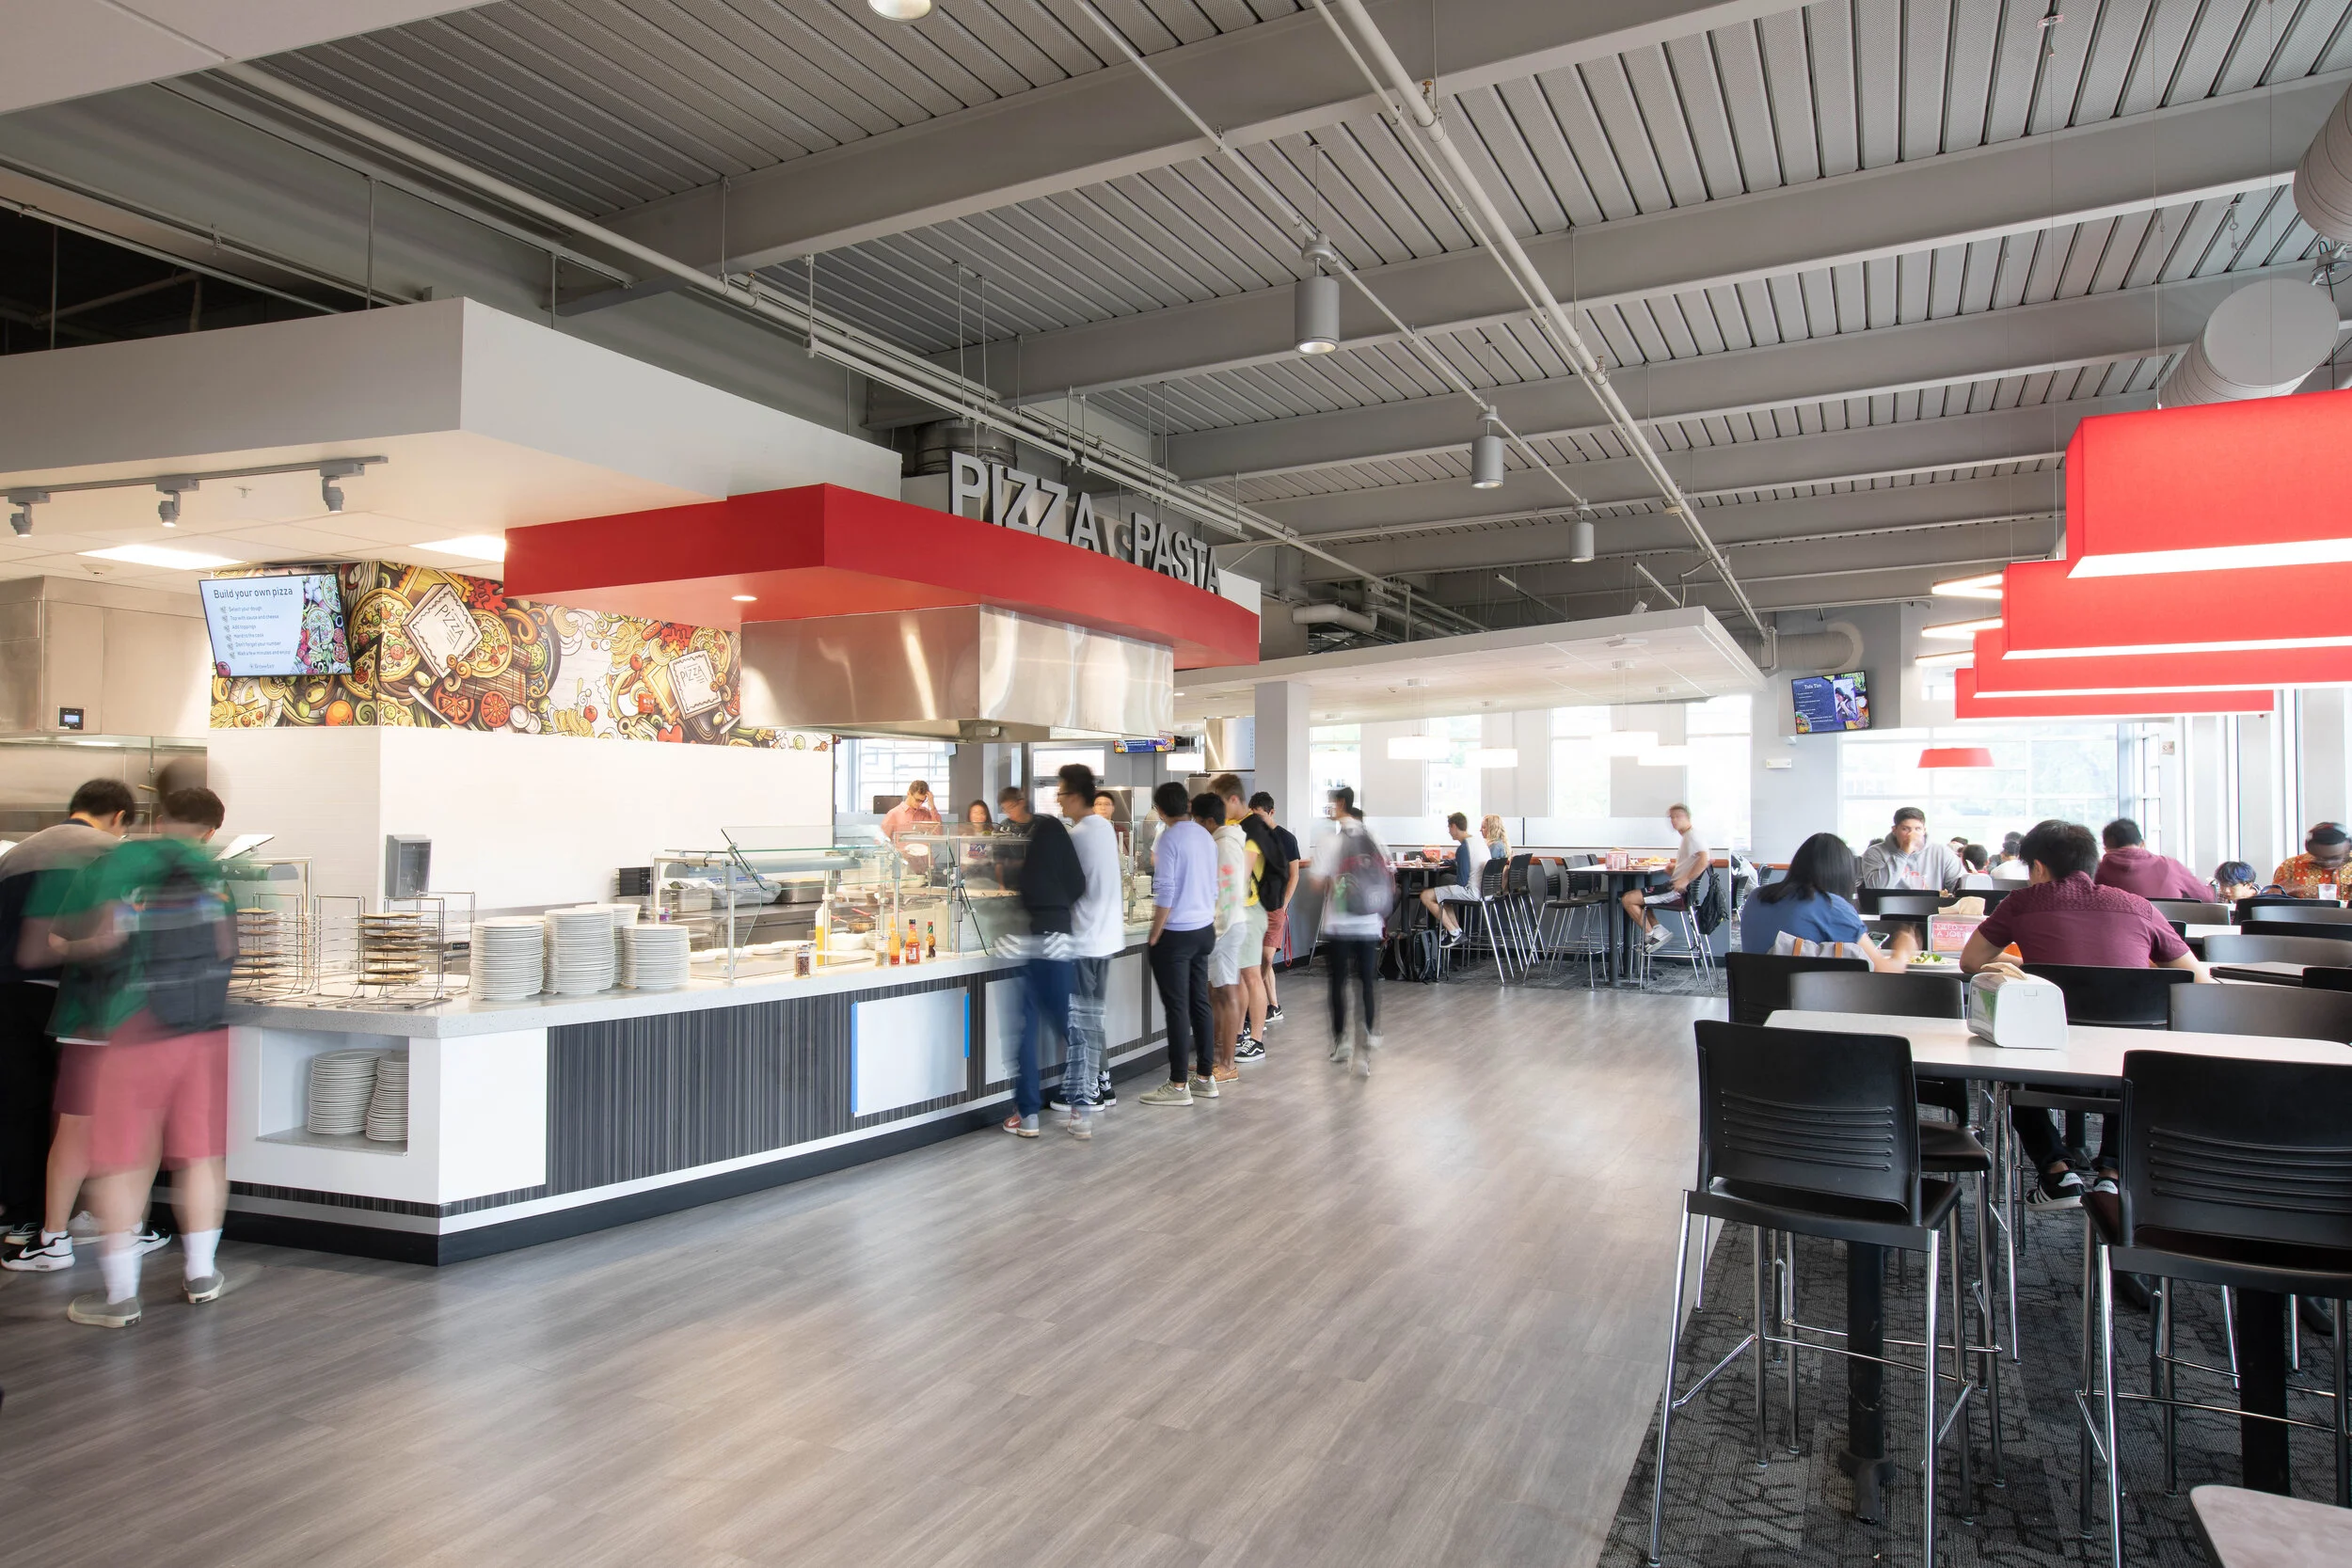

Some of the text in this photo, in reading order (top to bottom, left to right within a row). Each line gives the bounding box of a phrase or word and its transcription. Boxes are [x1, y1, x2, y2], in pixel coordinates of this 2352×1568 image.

[949, 451, 1222, 596] PIZZA PASTA
[214, 589, 233, 598] Build
[235, 590, 252, 599] your
[272, 588, 293, 597] pizza
